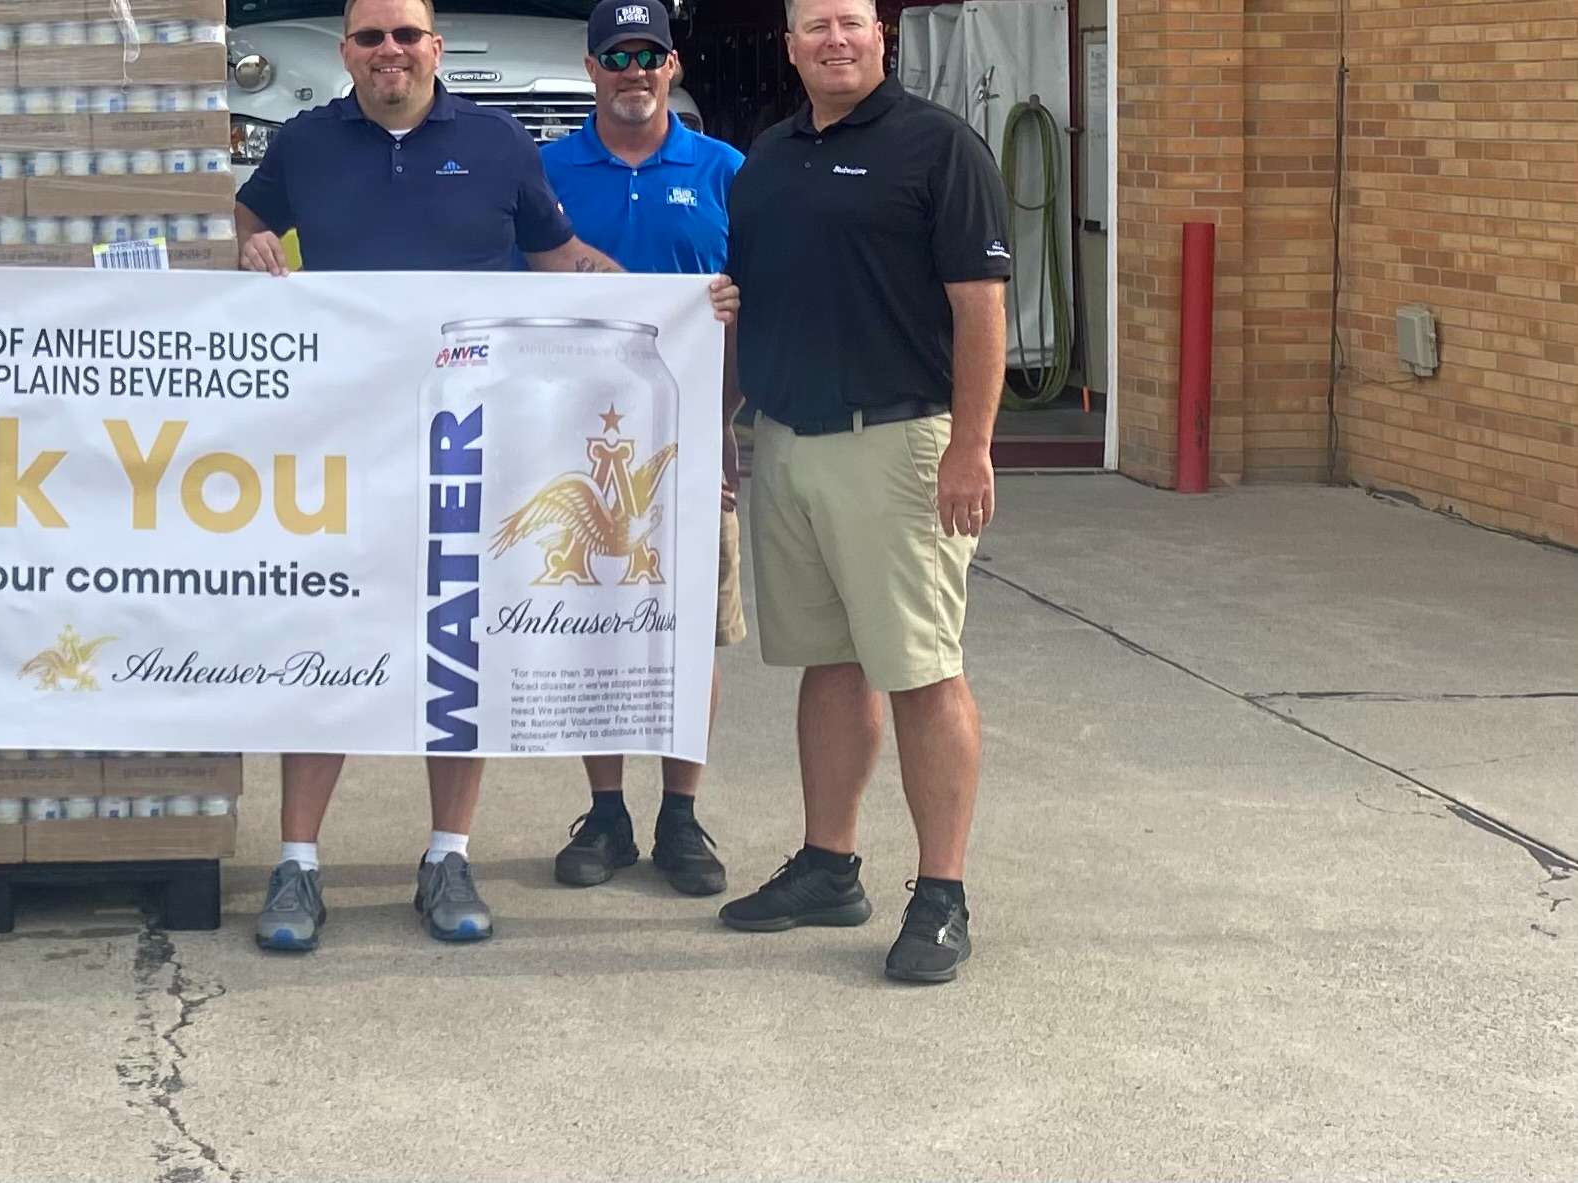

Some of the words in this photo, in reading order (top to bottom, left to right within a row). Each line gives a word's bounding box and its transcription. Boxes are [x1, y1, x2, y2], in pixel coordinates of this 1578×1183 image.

[31, 327, 319, 363] ANHEUSER-BUSCH
[450, 344, 490, 361] NVFC
[109, 366, 291, 400] BEVERAGES
[102, 419, 348, 536] You
[65, 560, 361, 598] communities.
[425, 402, 484, 753] WATER
[111, 646, 391, 688] Anheuser-Busch
